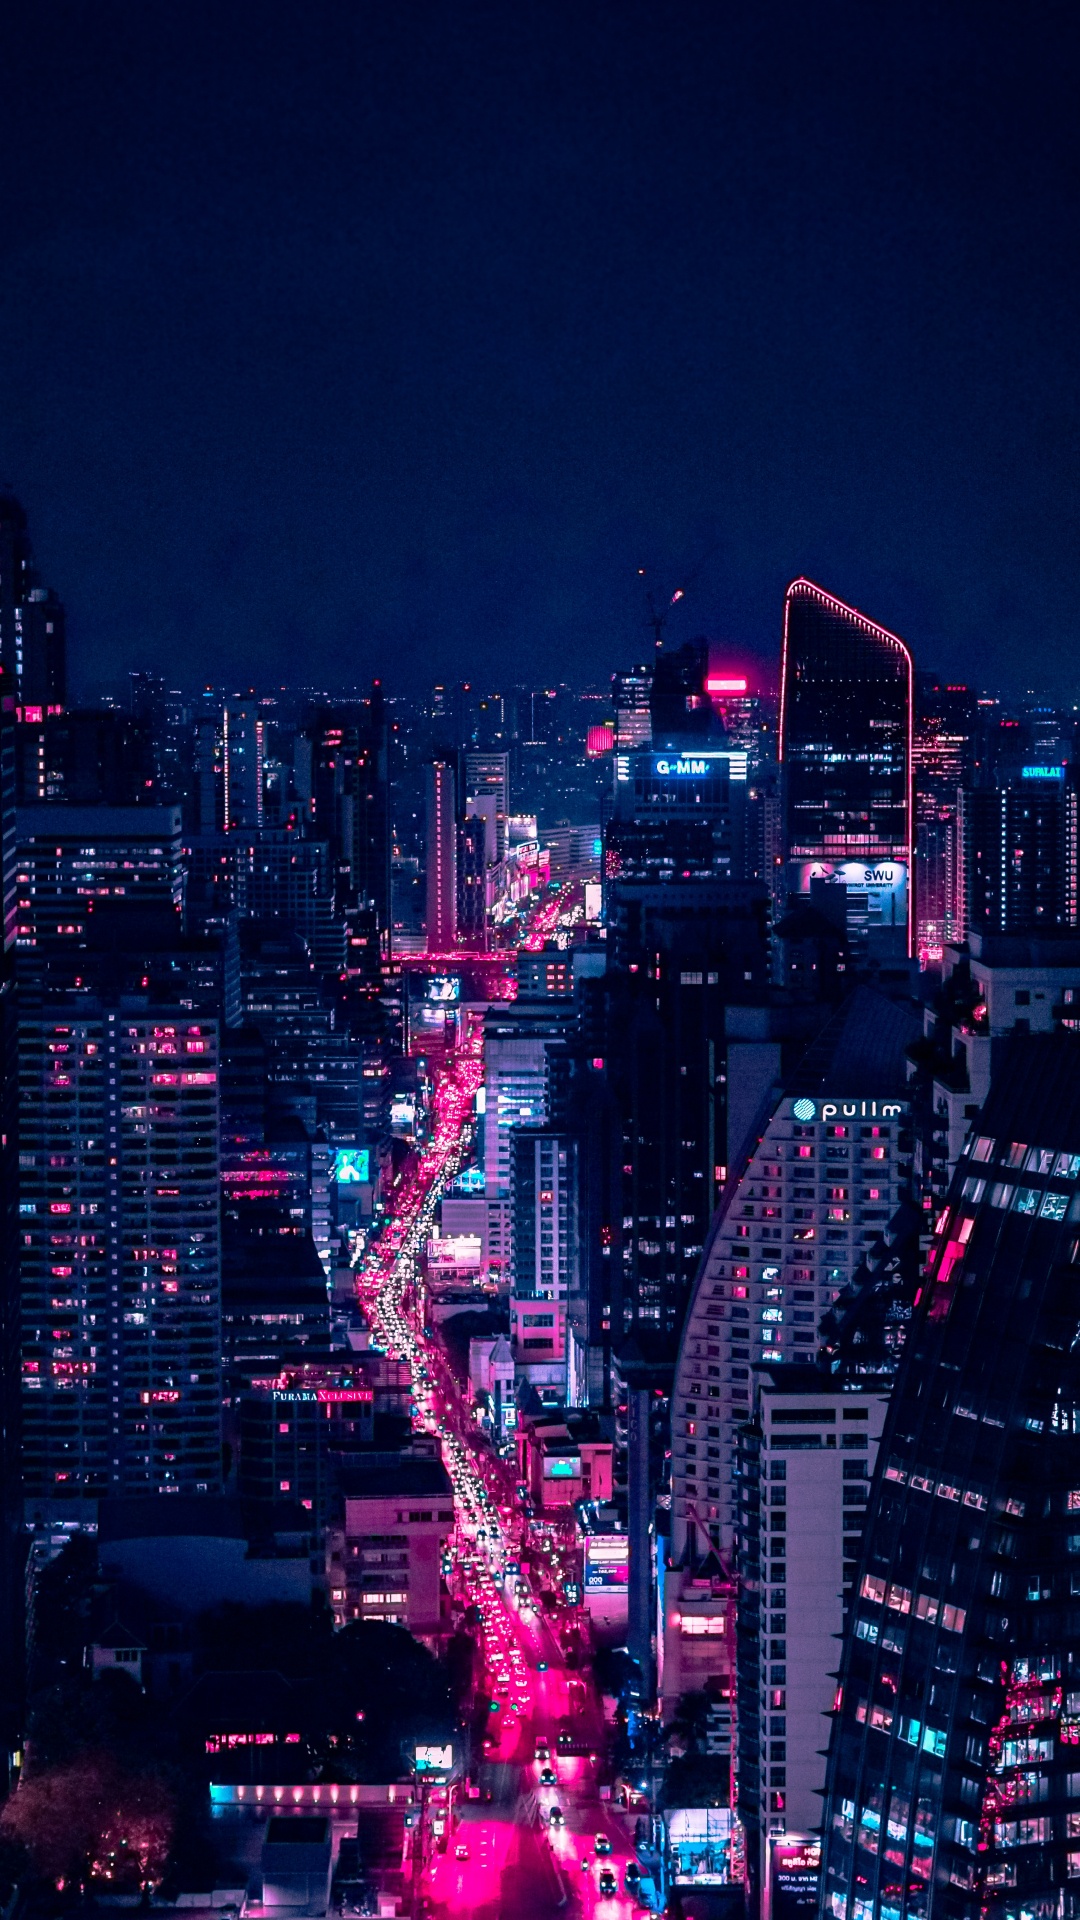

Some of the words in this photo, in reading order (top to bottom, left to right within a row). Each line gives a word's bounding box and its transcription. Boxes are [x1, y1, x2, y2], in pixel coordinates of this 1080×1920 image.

[1022, 767, 1061, 777] SUPALAI
[864, 870, 893, 881] SWU
[272, 1391, 317, 1401] FURAMA
